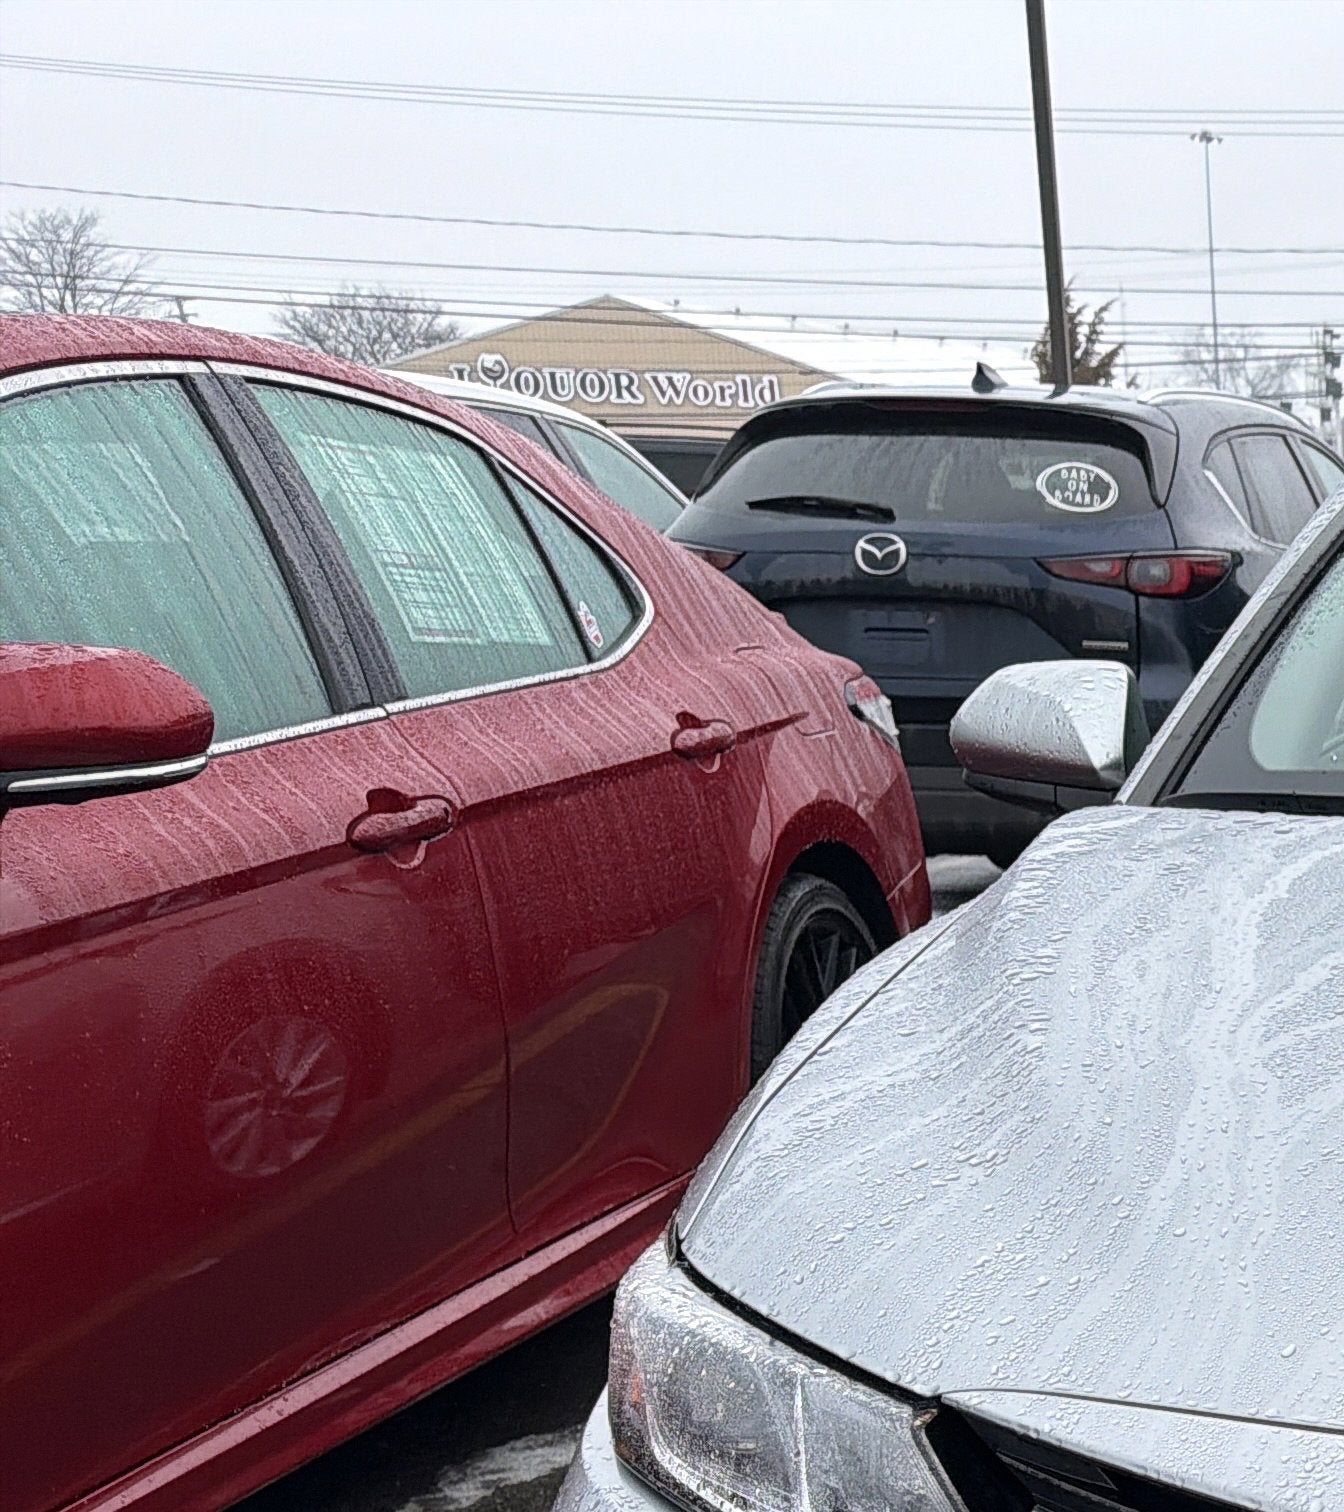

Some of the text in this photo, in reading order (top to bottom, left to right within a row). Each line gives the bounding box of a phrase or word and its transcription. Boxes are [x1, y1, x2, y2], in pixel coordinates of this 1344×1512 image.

[644, 371, 781, 408] World
[1061, 468, 1097, 482] BABY
[1068, 480, 1089, 492] ON
